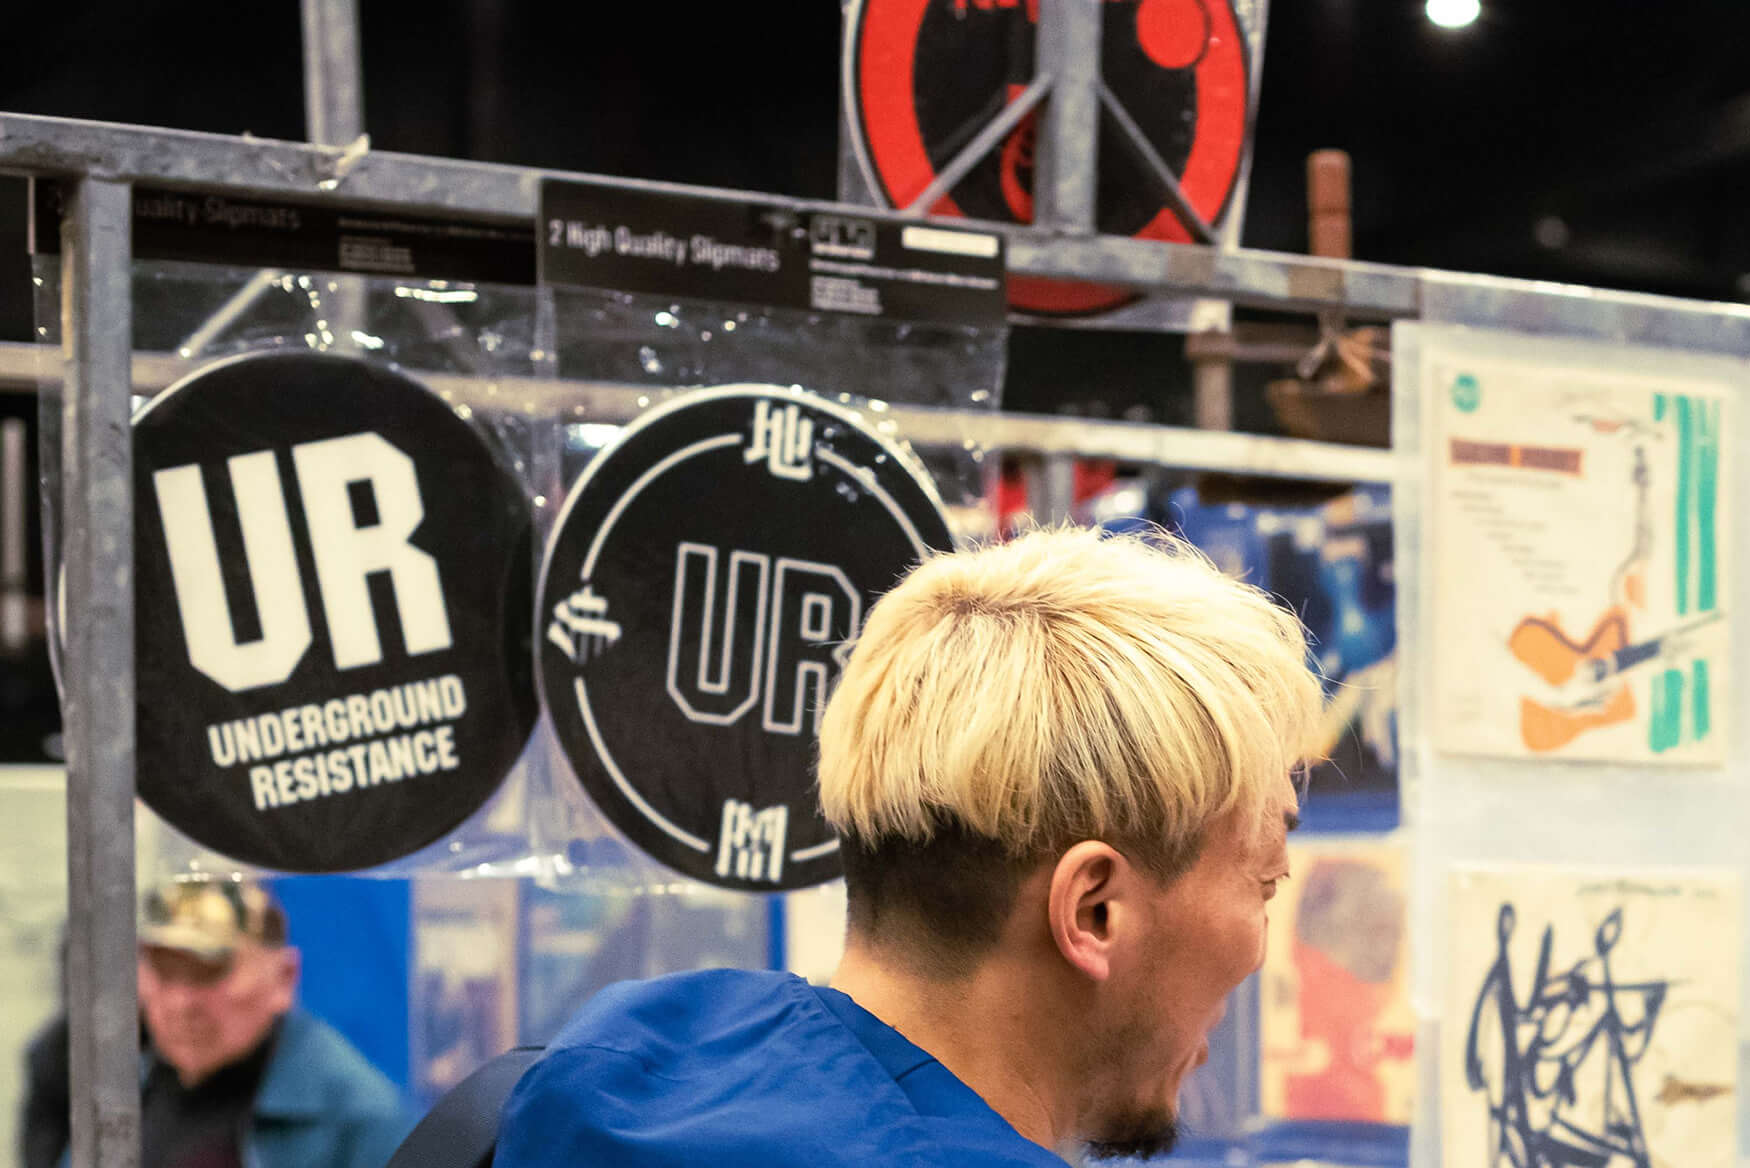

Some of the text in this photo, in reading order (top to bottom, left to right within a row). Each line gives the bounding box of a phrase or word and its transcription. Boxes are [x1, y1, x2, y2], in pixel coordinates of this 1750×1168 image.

[548, 220, 563, 246] 2
[565, 220, 610, 257] High
[614, 225, 686, 265] Quality
[690, 233, 780, 272] Slipmats
[152, 432, 453, 693] UR
[666, 540, 861, 737] UR
[206, 674, 467, 767] UNDERGROUND
[249, 726, 459, 811] RESISTANCE
